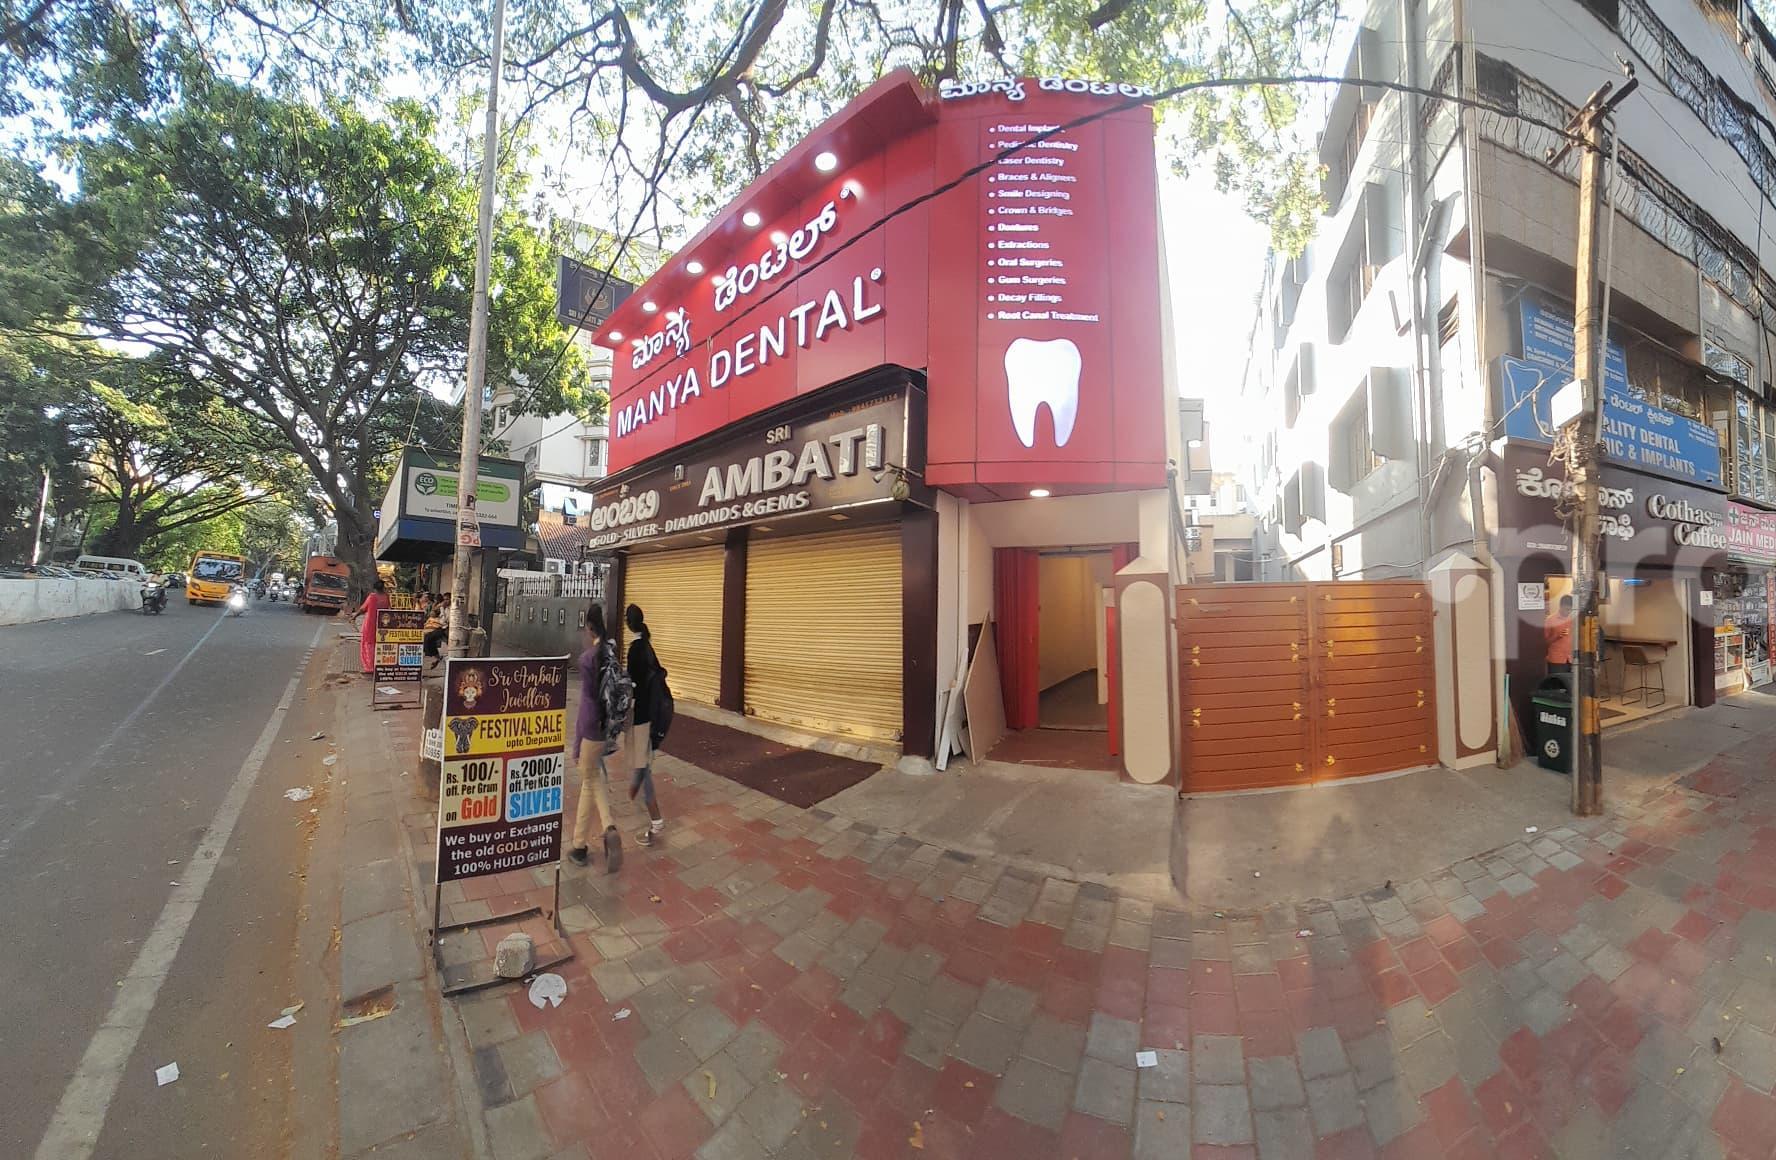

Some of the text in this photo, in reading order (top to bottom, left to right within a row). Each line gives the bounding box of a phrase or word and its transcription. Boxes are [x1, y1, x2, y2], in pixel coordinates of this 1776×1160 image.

[998, 125, 1026, 133] Dental
[1038, 141, 1078, 151] Dentistry
[1025, 157, 1065, 167] Dentistry
[1039, 174, 1077, 183] Aligners
[998, 190, 1070, 200] Smile Designing
[997, 206, 1028, 214] Crown
[1037, 207, 1074, 217] Bridges
[997, 240, 1050, 249] Extractions
[997, 258, 1064, 268] Oral Surgeries
[997, 276, 1066, 286] Gum Surgeries
[997, 293, 1063, 304] Decay Fillings
[997, 311, 1099, 322] Root Canal Treatment
[616, 275, 881, 438] MANYA DENTAL
[766, 425, 792, 445] SRI
[1640, 427, 1681, 454] DENTAL
[698, 423, 886, 507] AMBATI
[1628, 445, 1637, 460] &
[1641, 445, 1696, 477] IMPLANTS
[1648, 494, 1714, 525] Cothas
[1674, 522, 1727, 550] Coffee
[1728, 527, 1753, 546] JAIN
[488, 665, 561, 689] Sri Ambati
[479, 714, 562, 740] FESTIVAL SALE
[506, 737, 524, 749] upto
[446, 761, 499, 784] Rs. 100/-
[521, 756, 562, 778] 2000/-
[446, 783, 497, 796] off. Per Gram
[539, 777, 549, 788] KG
[550, 776, 562, 785] on
[446, 795, 497, 821] on Gold
[509, 787, 561, 819] SILVER
[445, 821, 559, 846] We buy or Exchange
[451, 834, 552, 860] the old GOLD with
[453, 861, 491, 875] 100%
[493, 854, 525, 869] HUID
